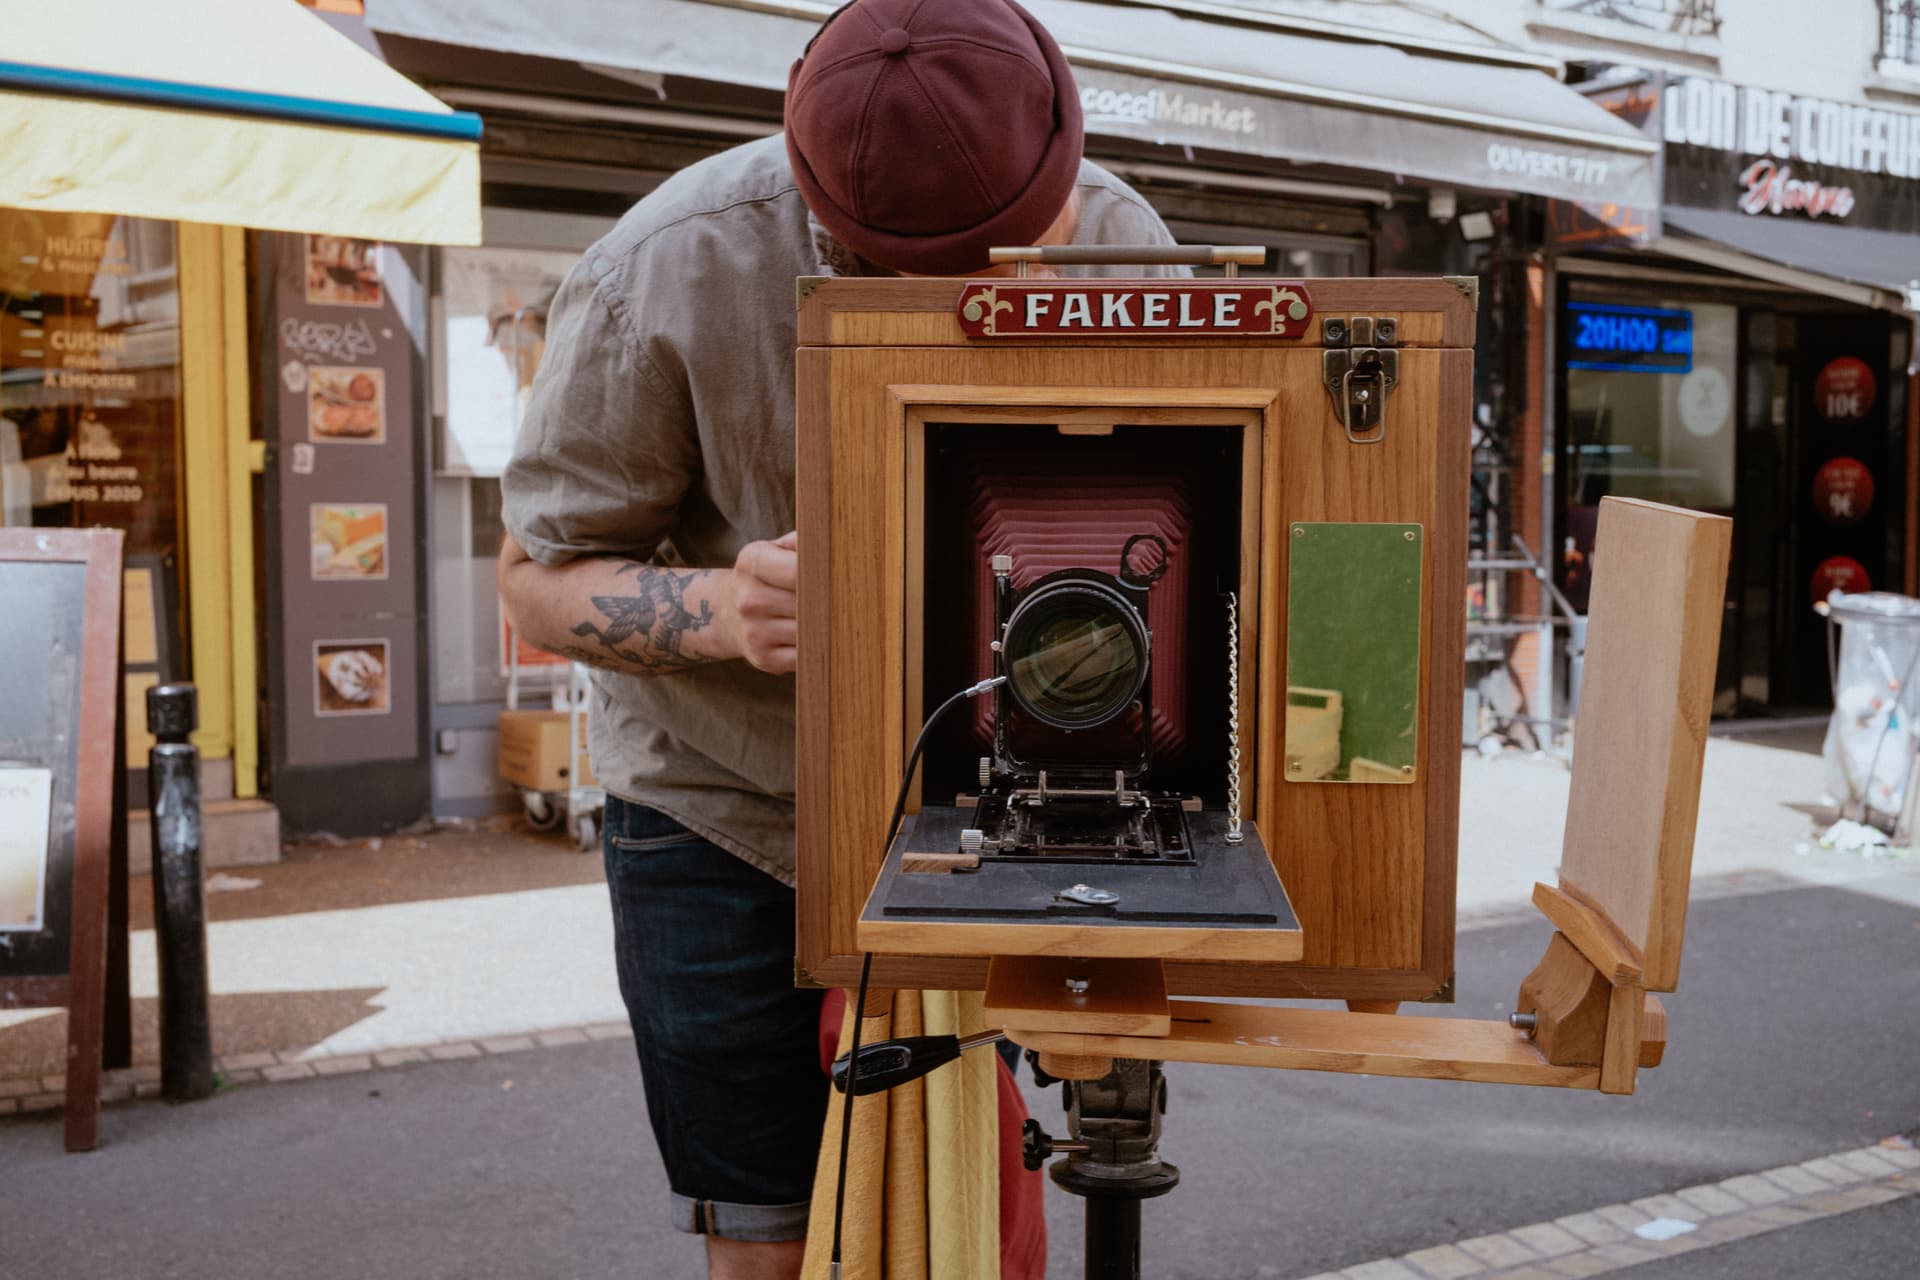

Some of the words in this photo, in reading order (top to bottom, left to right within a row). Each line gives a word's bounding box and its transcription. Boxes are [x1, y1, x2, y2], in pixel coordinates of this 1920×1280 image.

[1746, 87, 1791, 159] DE
[1487, 143, 1568, 179] OUVERT
[1568, 157, 1609, 185] 7/7
[1025, 293, 1242, 327] FAKELE
[1576, 313, 1658, 352] 20H00
[61, 371, 136, 390] EMPORTER
[102, 485, 143, 502] 2020
